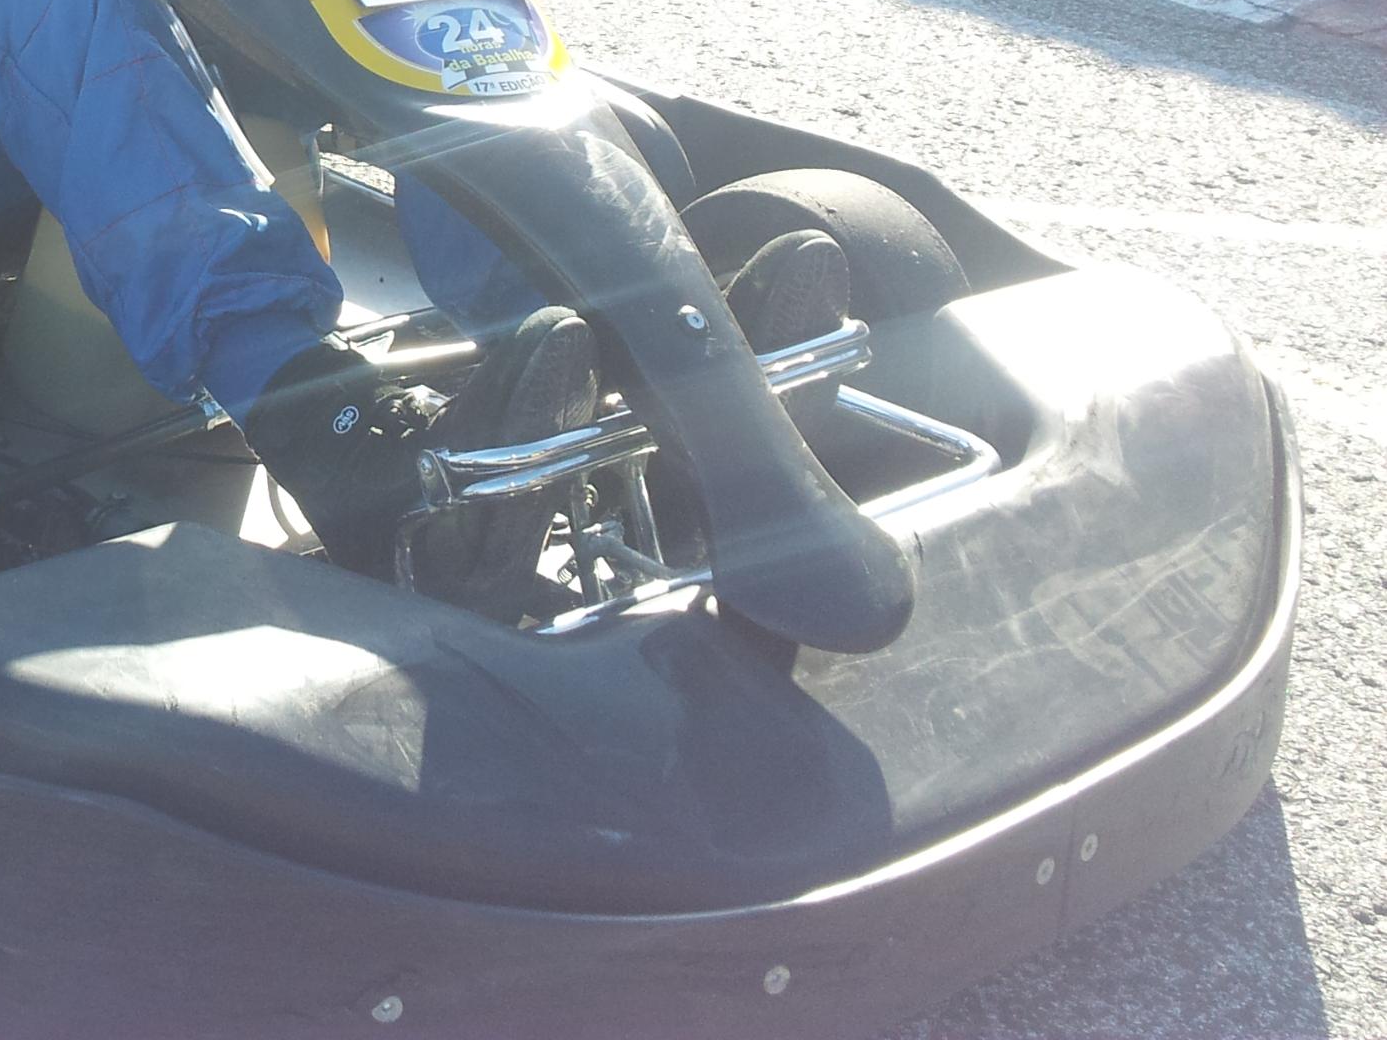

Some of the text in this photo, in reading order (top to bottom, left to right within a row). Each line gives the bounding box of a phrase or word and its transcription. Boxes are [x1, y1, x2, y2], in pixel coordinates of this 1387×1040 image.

[427, 9, 502, 53] 24
[448, 48, 534, 72] da Batalha
[500, 73, 546, 93] EDIÇÃO
